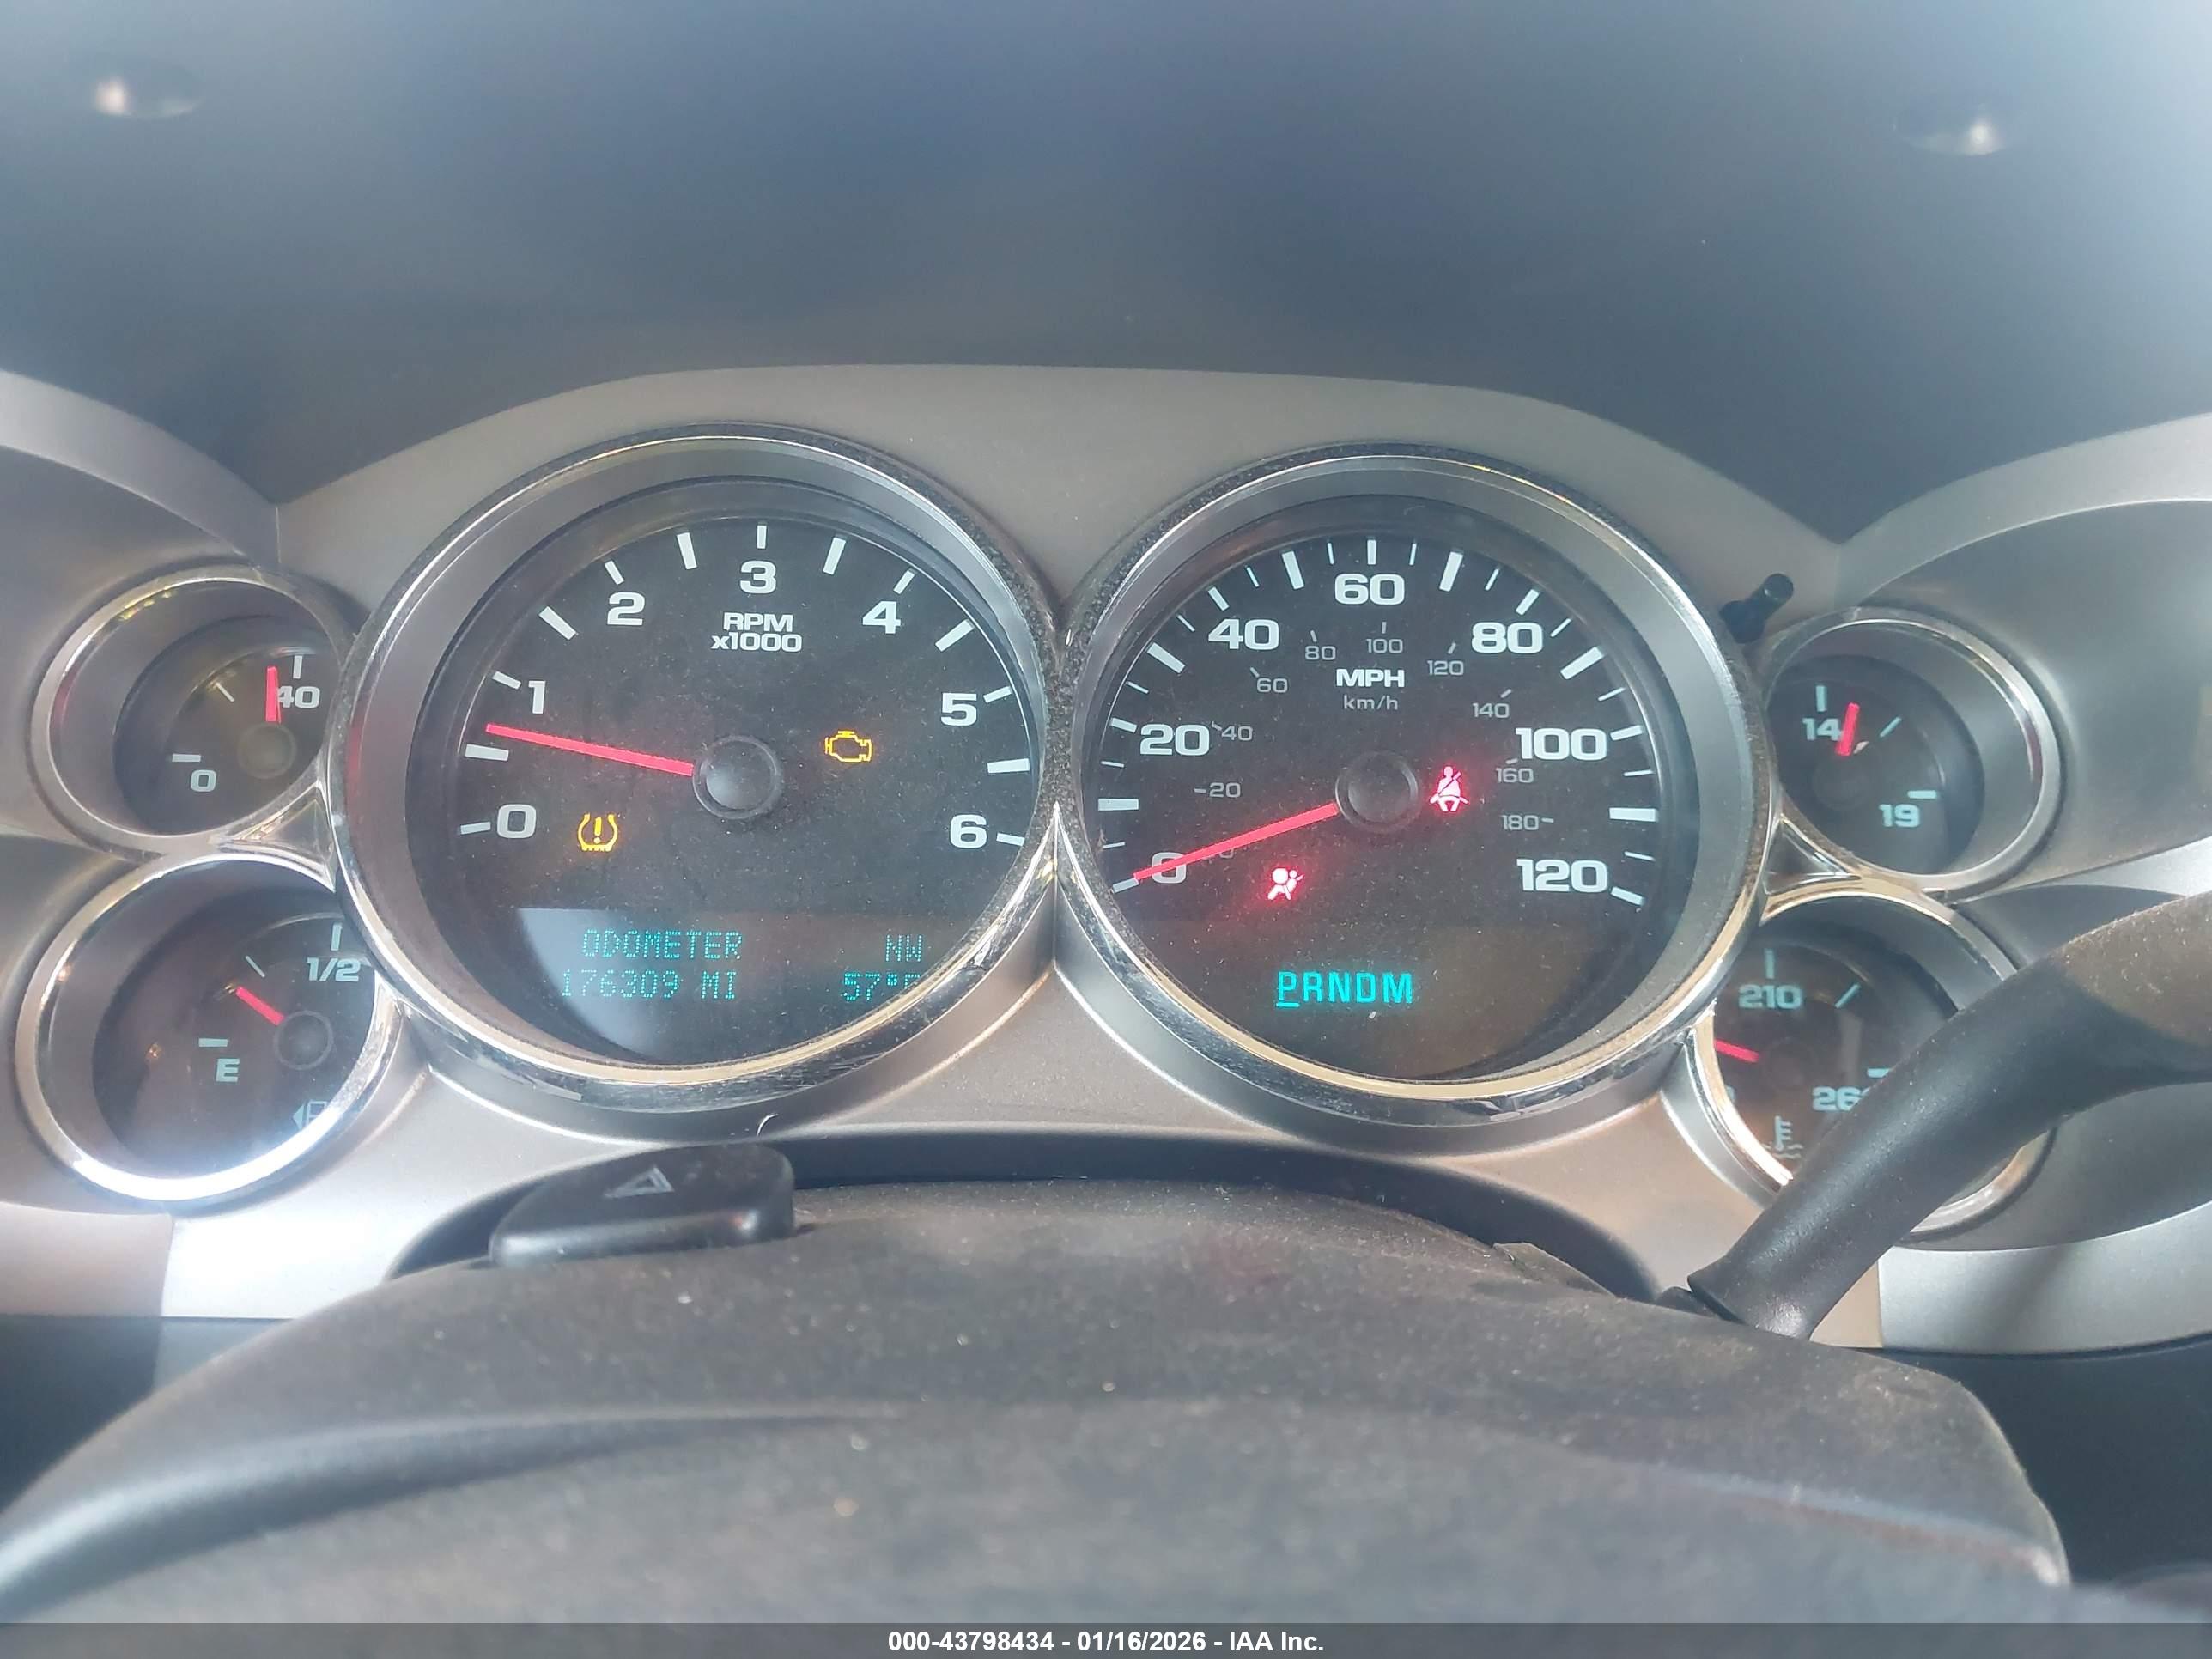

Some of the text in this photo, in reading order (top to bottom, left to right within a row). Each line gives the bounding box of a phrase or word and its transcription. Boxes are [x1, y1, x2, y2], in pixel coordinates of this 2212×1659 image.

[740, 561, 776, 593] 3
[1335, 574, 1404, 605] 60
[608, 592, 645, 625] 2
[863, 601, 901, 633] 4
[723, 612, 793, 631] RPM
[710, 634, 803, 653] x1000
[1208, 619, 1279, 649] 40
[1367, 639, 1402, 653] 100
[1472, 623, 1542, 653] 80
[1305, 646, 1335, 659] 80
[1337, 669, 1404, 687] MPH
[1428, 661, 1463, 675] 120
[278, 686, 319, 708] 40
[1256, 677, 1288, 693] 60
[529, 681, 545, 714] 1
[941, 693, 976, 726] 5
[1344, 695, 1397, 709] km/h
[1473, 703, 1509, 718] 140
[1140, 724, 1209, 755] 20
[1218, 726, 1253, 740] 40
[1802, 718, 1844, 741] 14
[1515, 727, 1607, 760] 100
[1497, 768, 1534, 782] 160
[1210, 783, 1240, 797] 20
[497, 805, 536, 838] 0
[1502, 815, 1539, 830] 180
[1881, 805, 1919, 827] 19
[951, 815, 987, 848] 6
[1517, 859, 1607, 892] 120
[582, 928, 743, 959] ODOMETER
[885, 934, 921, 962] NW
[307, 958, 360, 981] 1/2
[562, 968, 737, 1000] 176309 MI
[1276, 971, 1413, 1006] PRNDM
[1740, 984, 1802, 1008] 210
[216, 1059, 240, 1081] E
[1812, 1086, 1869, 1111] 26
